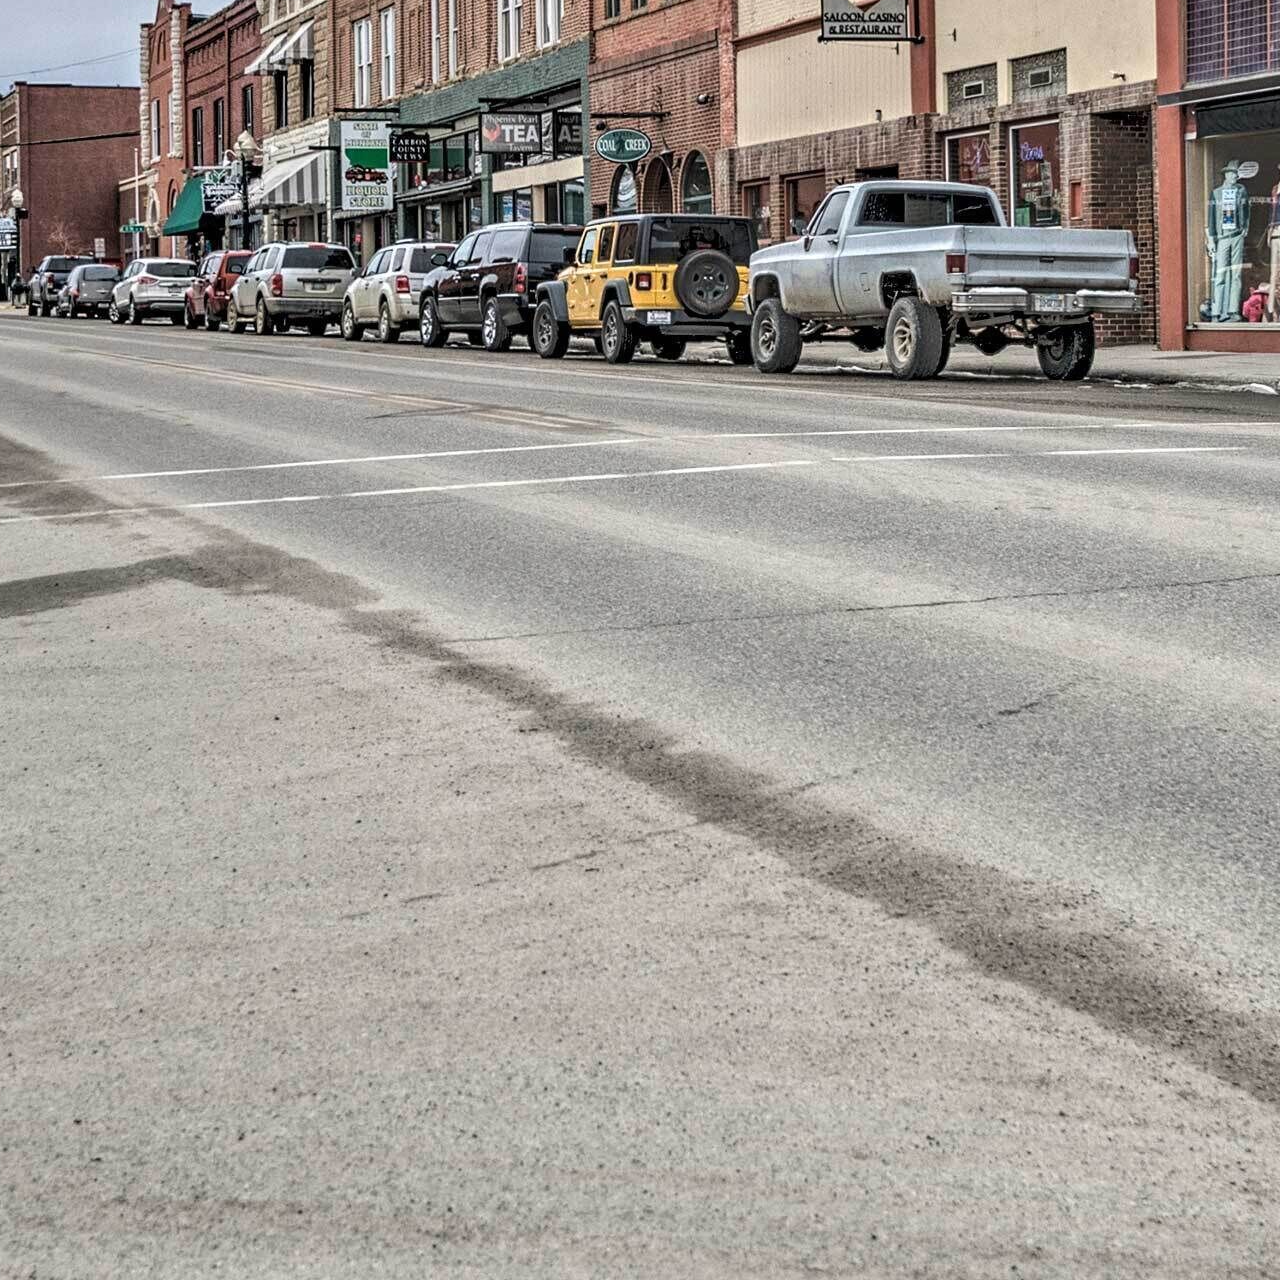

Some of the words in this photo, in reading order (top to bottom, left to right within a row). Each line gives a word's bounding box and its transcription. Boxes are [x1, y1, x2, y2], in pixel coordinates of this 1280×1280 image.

[869, 13, 904, 22] CASINO
[829, 26, 837, 34] &
[839, 24, 901, 35] RESTAURANT
[501, 125, 539, 142] TEA
[392, 138, 427, 146] CARBON
[599, 139, 616, 152] COAL
[624, 138, 648, 151] CREEK
[346, 186, 388, 195] LIQUOR
[350, 197, 384, 207] STORE
